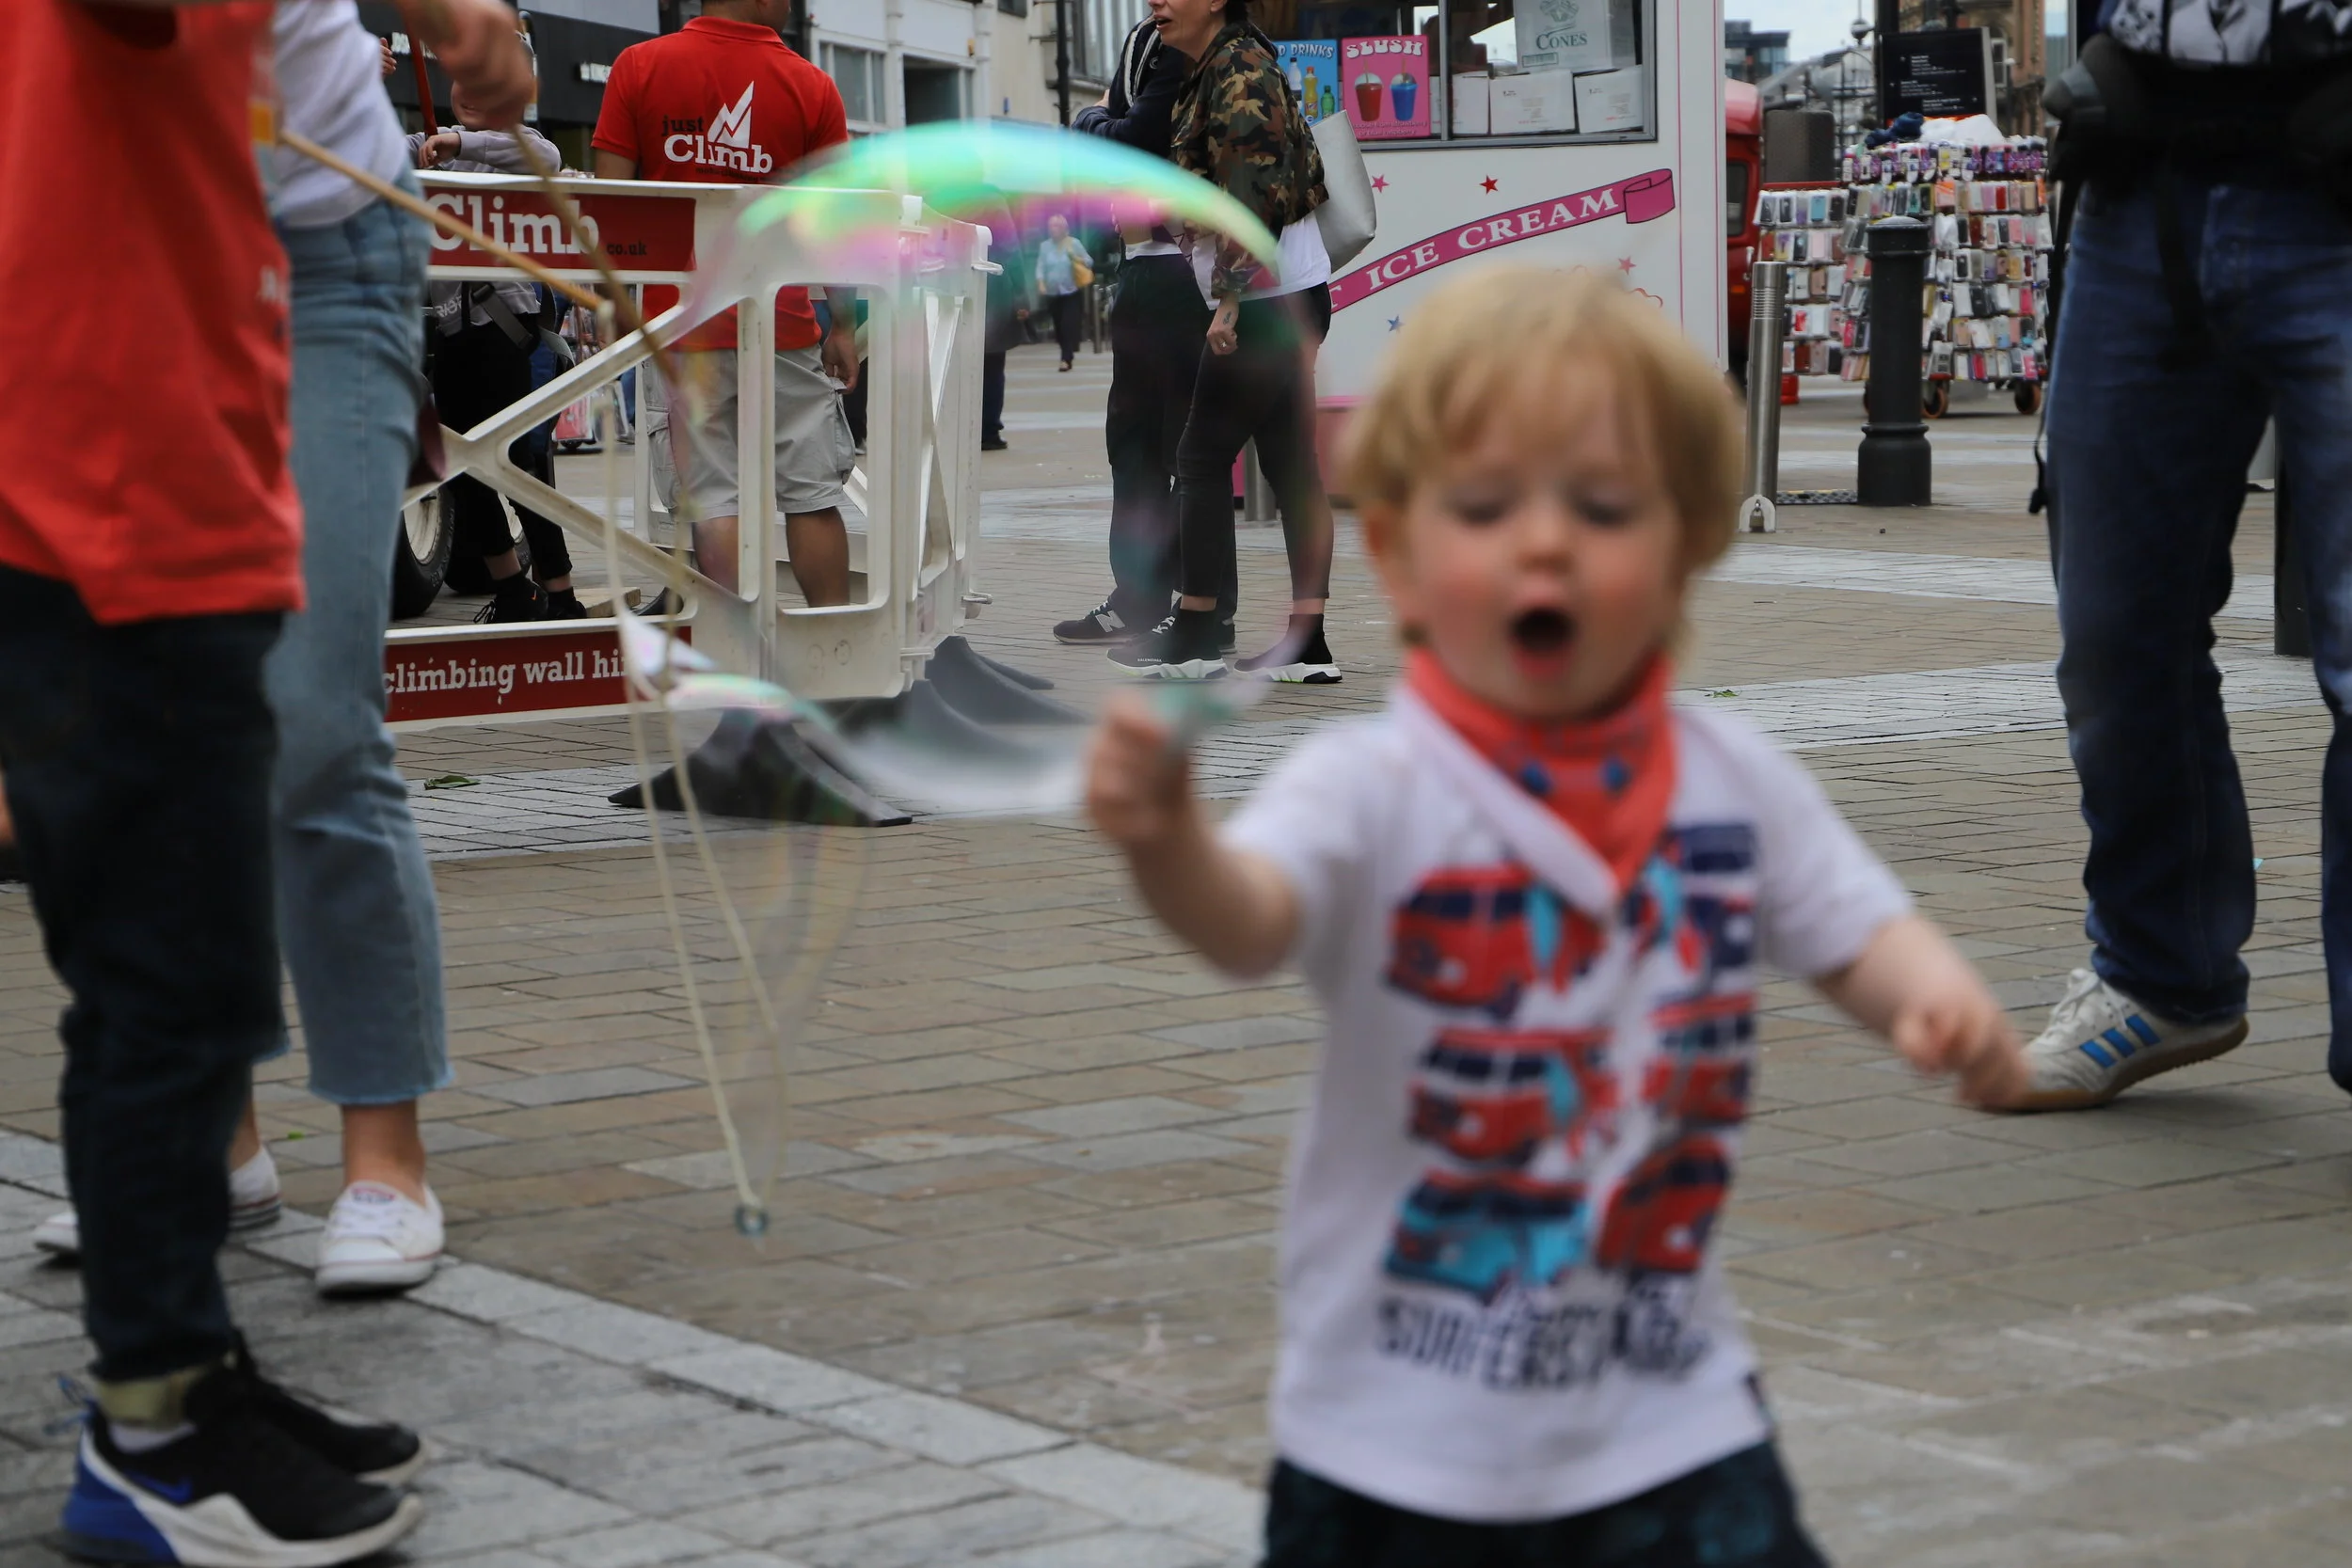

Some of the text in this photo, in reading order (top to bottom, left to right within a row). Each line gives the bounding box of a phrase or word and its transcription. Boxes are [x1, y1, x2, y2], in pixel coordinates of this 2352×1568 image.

[1290, 43, 1334, 57] DRINKS
[1346, 40, 1422, 58] SLUSH
[1535, 31, 1588, 51] CONES
[661, 115, 704, 136] just
[664, 134, 772, 173] Climb
[425, 193, 599, 254] Climb
[606, 239, 647, 256] co.uk
[1366, 188, 1618, 291] ICE CREAM
[381, 648, 626, 694] climbing wall hi
